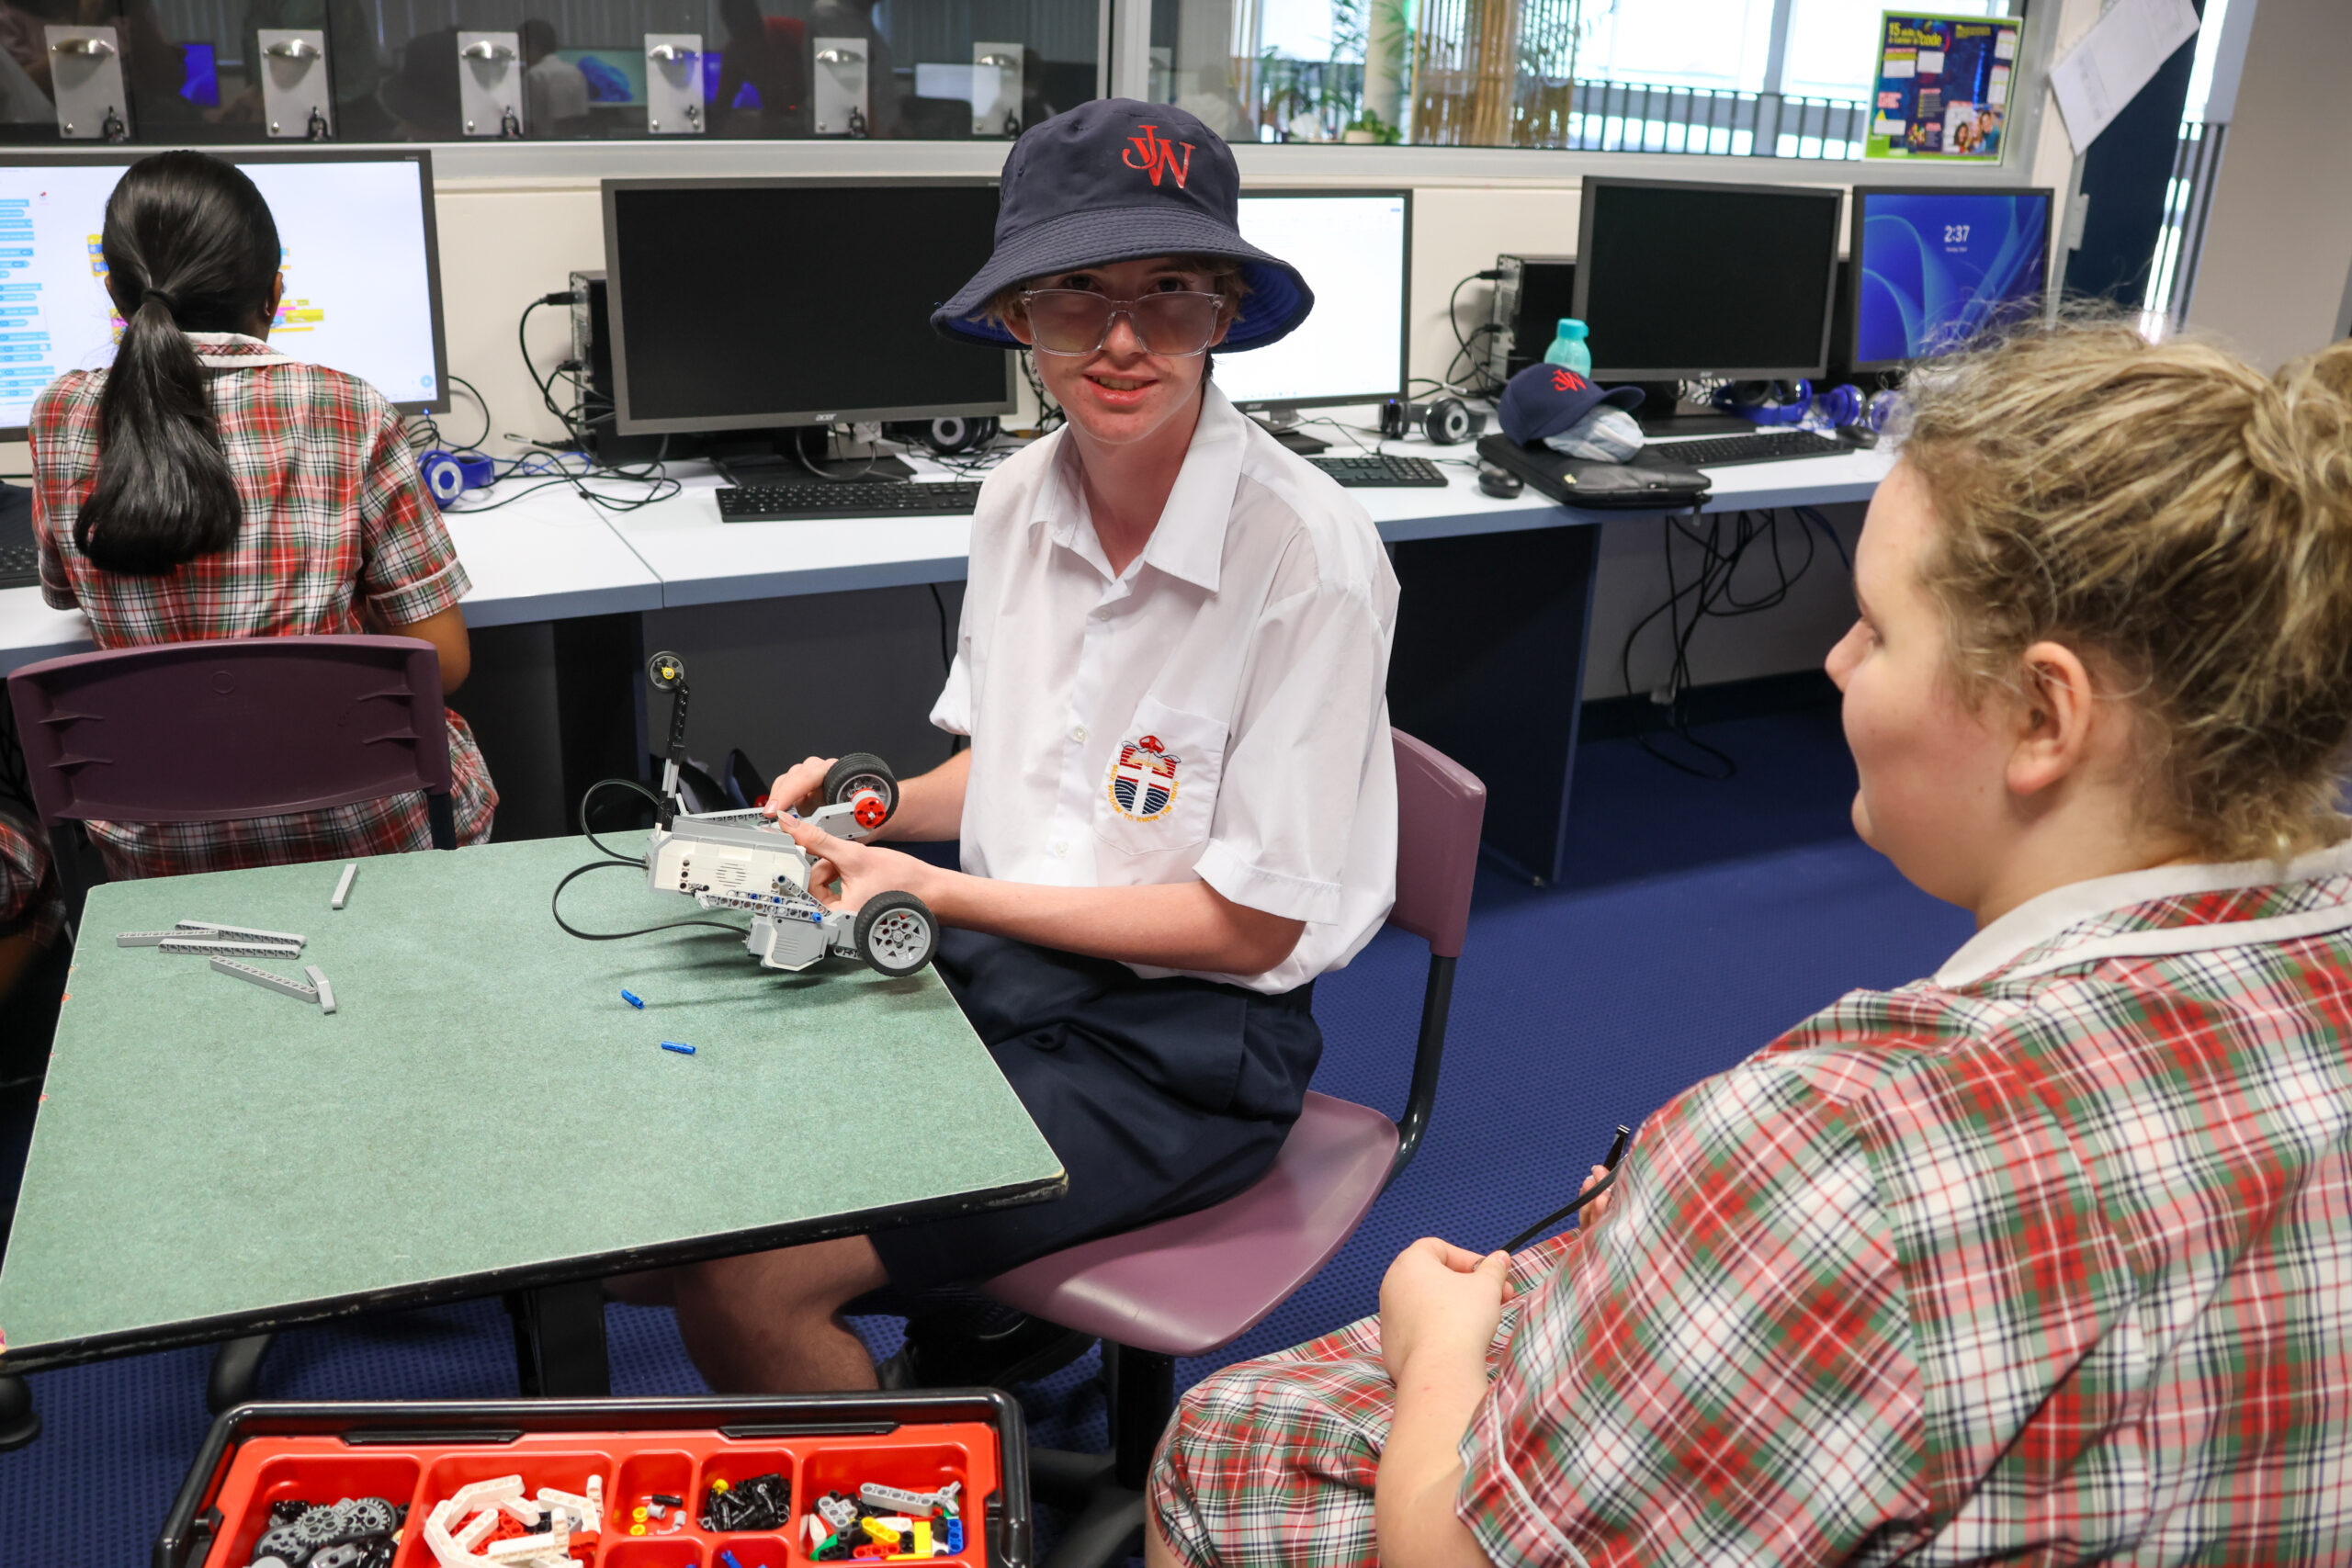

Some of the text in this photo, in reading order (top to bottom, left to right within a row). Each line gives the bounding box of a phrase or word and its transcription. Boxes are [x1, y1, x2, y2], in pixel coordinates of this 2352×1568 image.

[1122, 124, 1196, 189] JW
[1944, 225, 1970, 243] 2:37
[816, 413, 837, 422] acer
[1124, 812, 1134, 821] TO
[1136, 815, 1159, 823] KNOW
